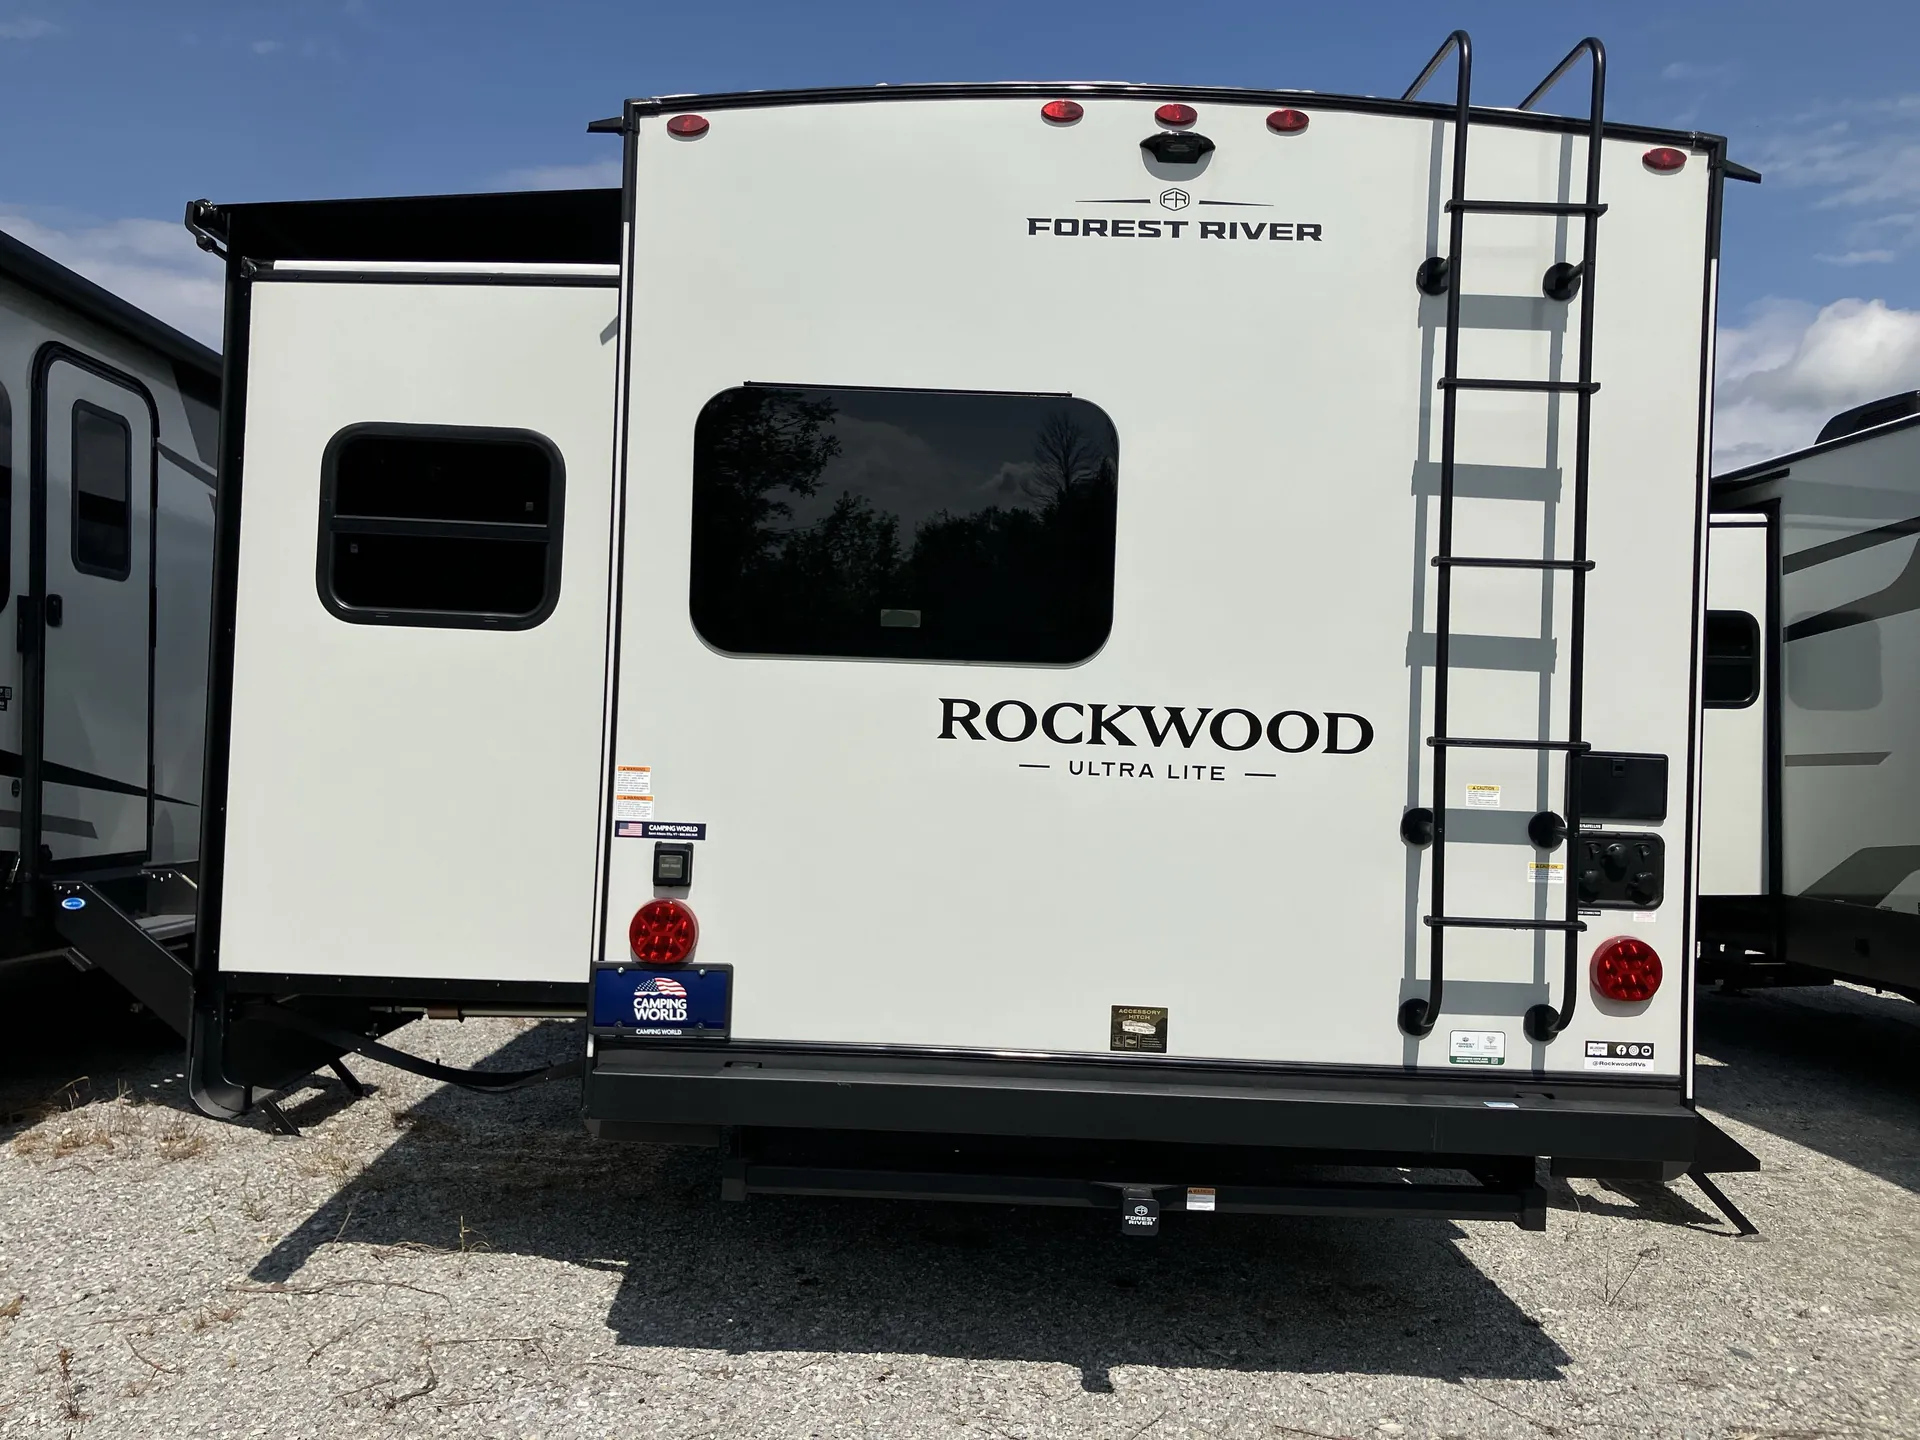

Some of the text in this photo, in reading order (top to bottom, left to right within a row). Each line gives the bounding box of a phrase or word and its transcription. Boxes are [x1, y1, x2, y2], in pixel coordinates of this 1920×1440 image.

[1026, 217, 1323, 242] FOREST RIVER
[936, 697, 1375, 755] ROCKWOOD
[1069, 760, 1226, 781] ULTRA LITE
[648, 824, 676, 832] CAMPING
[633, 997, 687, 1010] CAMPING
[633, 1008, 688, 1021] WORLD
[661, 1028, 682, 1036] WORLD
